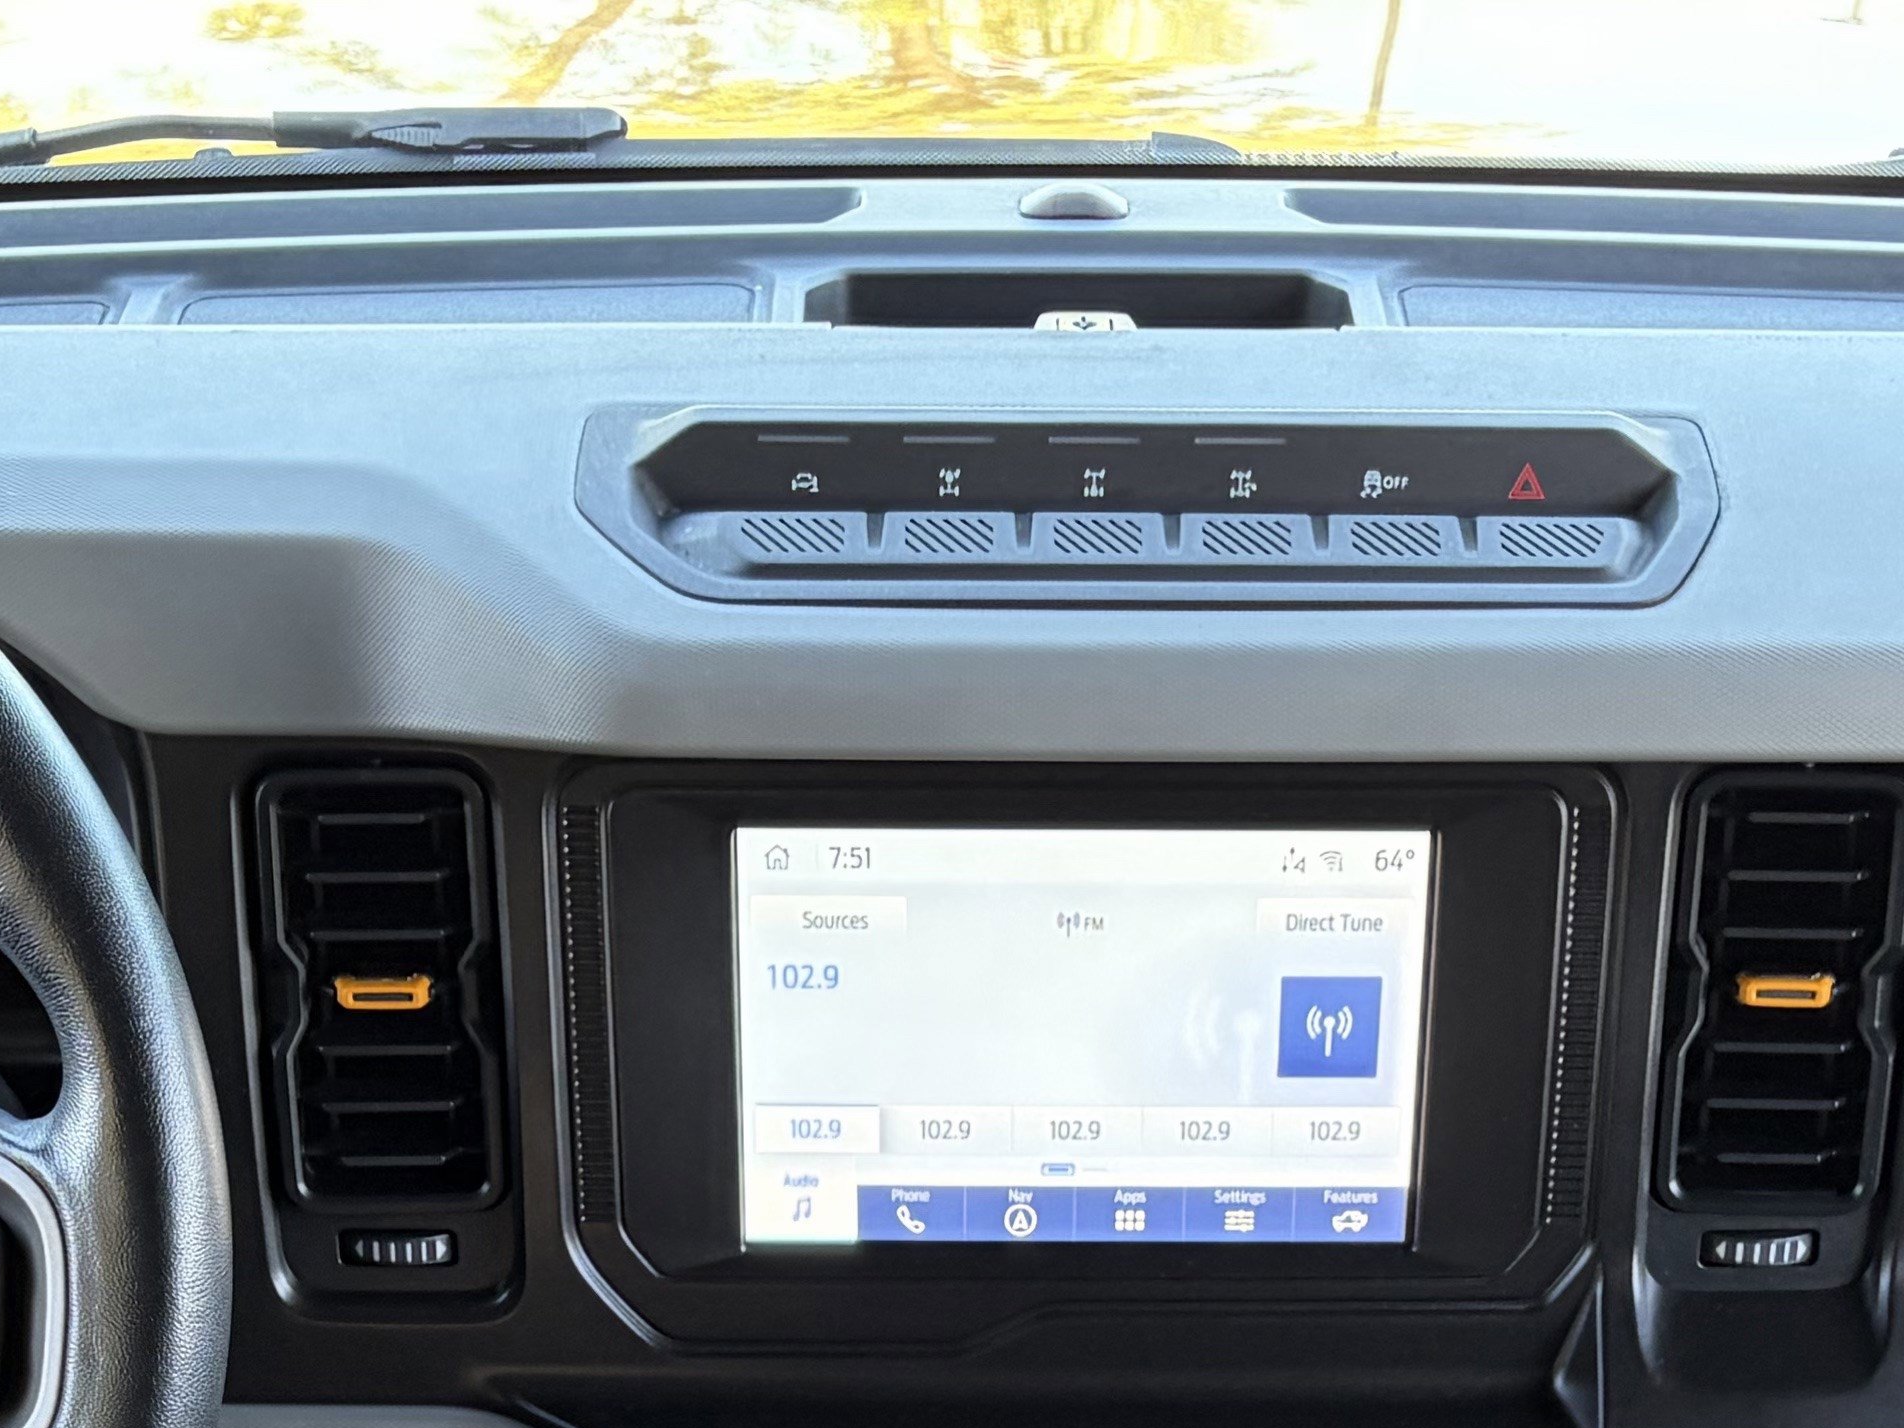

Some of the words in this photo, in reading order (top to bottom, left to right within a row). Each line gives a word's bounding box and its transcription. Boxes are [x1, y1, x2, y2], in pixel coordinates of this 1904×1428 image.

[1383, 475, 1409, 490] OFF
[828, 846, 872, 869] 7:51
[1375, 849, 1415, 872] 64°
[802, 911, 869, 930] Sources
[1084, 917, 1104, 931] FM
[1285, 913, 1335, 932] Direct
[1340, 914, 1384, 932] Tune
[767, 964, 840, 990] 102.9
[790, 1118, 842, 1139] 102.9
[920, 1119, 971, 1140] 102.9
[1050, 1120, 1101, 1140] 102.9
[1180, 1121, 1231, 1141] 102.9
[1310, 1121, 1361, 1142] 102.9
[783, 1174, 819, 1188] Audio
[891, 1188, 931, 1203] Phone
[1008, 1188, 1033, 1203] Nav
[1114, 1189, 1147, 1206] Apps
[1214, 1189, 1267, 1206] Settings
[1323, 1190, 1378, 1204] Features
